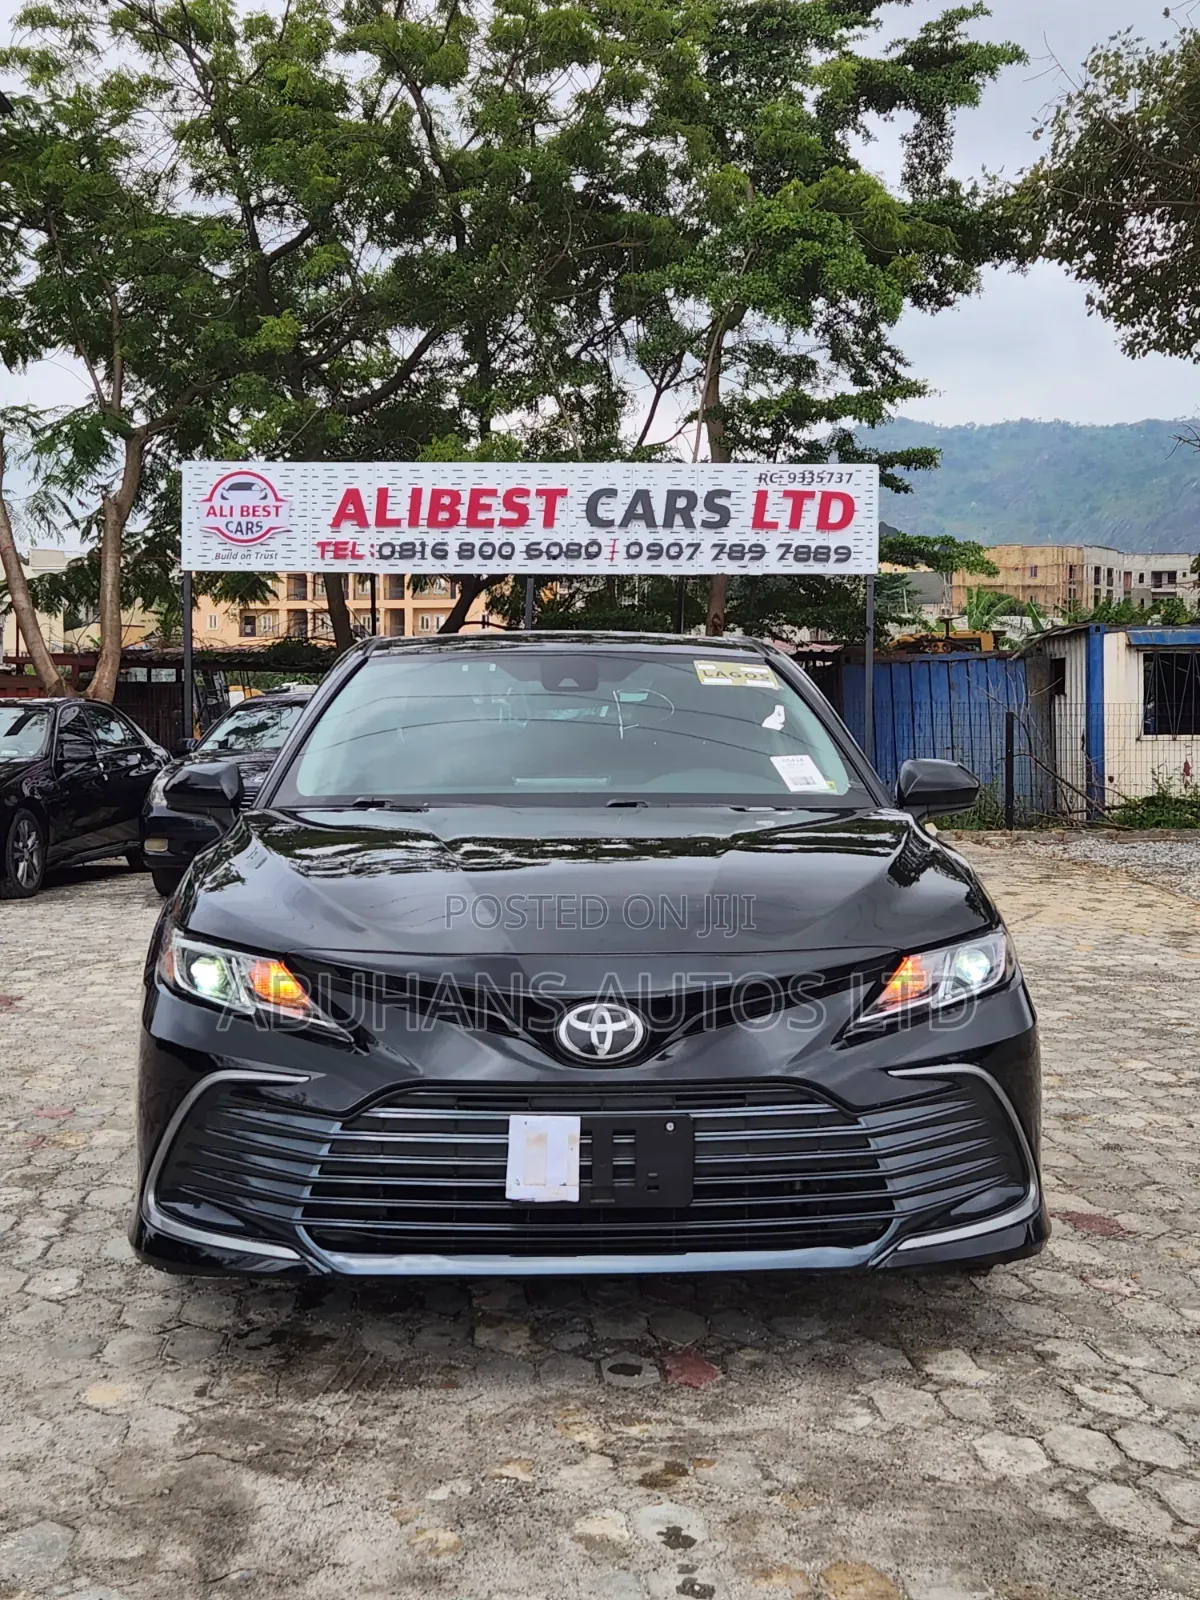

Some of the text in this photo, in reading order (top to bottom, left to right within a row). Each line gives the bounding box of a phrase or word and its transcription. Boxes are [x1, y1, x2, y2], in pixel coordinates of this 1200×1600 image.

[205, 505, 283, 518] ALI BEST
[330, 487, 856, 532] ALIBEST CARS LTD
[225, 520, 264, 536] CARS
[214, 551, 239, 561] Build
[255, 551, 279, 560] Trust
[457, 541, 516, 561] 800
[525, 540, 603, 560] 6080
[625, 541, 701, 562] 0907
[710, 542, 767, 563] 789
[776, 543, 852, 564] 7889
[702, 669, 770, 681] LAGOS
